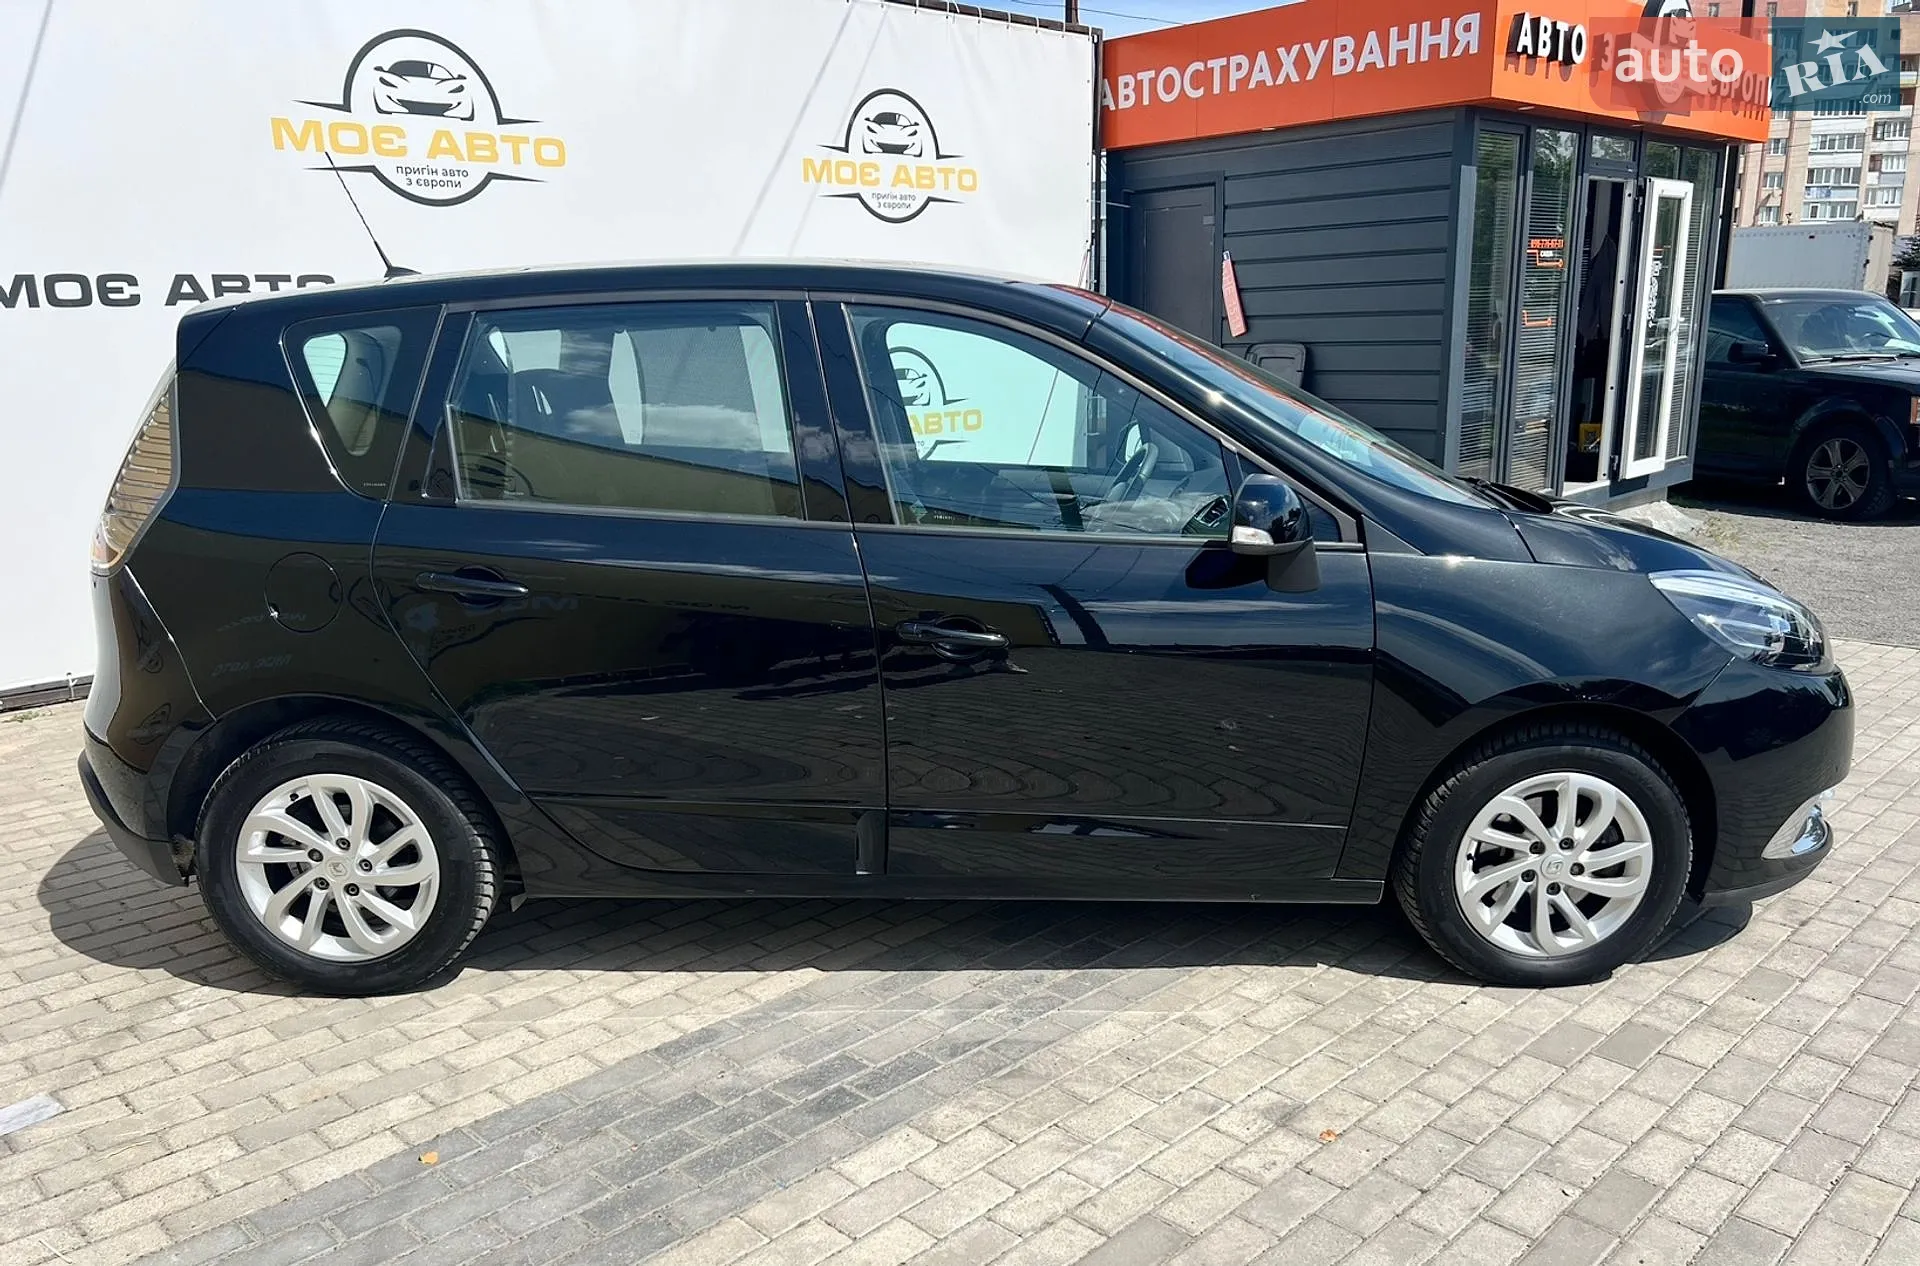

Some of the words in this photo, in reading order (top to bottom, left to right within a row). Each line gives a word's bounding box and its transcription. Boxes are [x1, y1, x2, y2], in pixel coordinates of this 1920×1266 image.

[1516, 11, 1587, 65] АВТО
[1101, 12, 1481, 111] АВТОСТРАХУВАННЯ
[270, 117, 408, 158] МОЄ
[426, 130, 567, 168] АВТО
[395, 165, 438, 176] пригін
[441, 168, 469, 178] авто
[416, 178, 462, 189] європи
[802, 157, 881, 187] МОЄ
[890, 164, 978, 192] АВТО
[899, 194, 917, 202] авто
[0, 273, 142, 309] МОЄ
